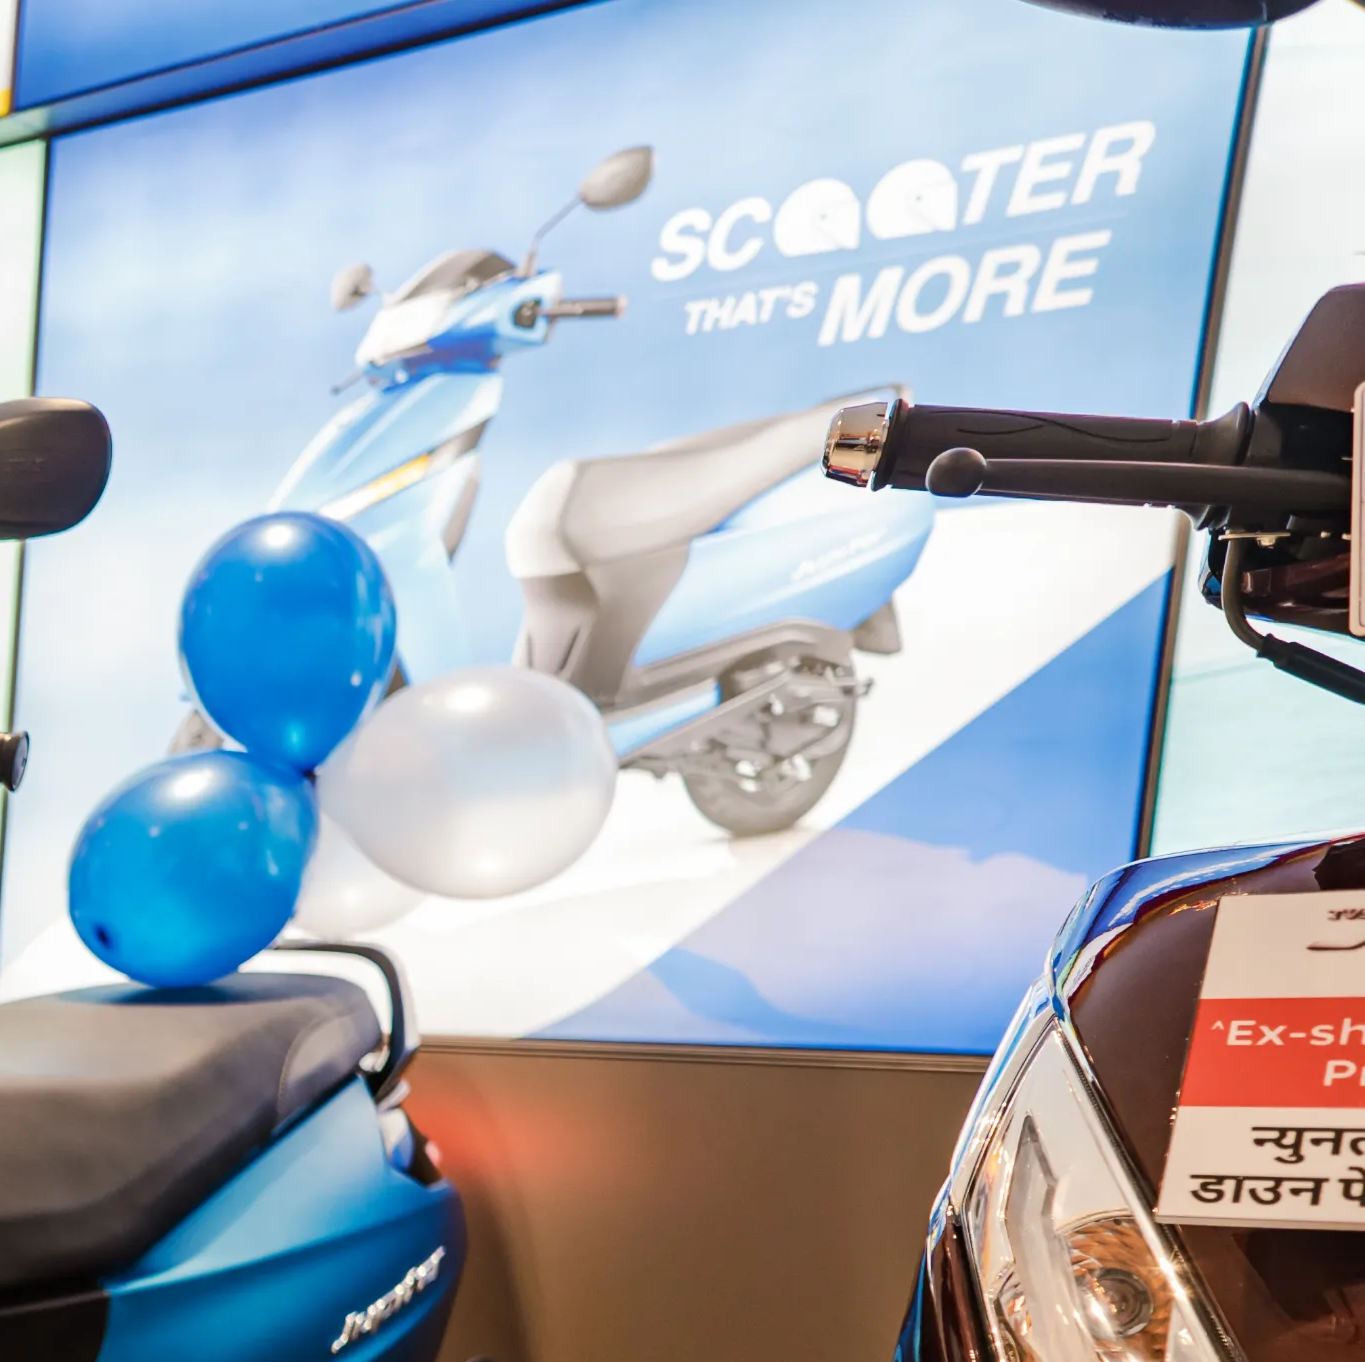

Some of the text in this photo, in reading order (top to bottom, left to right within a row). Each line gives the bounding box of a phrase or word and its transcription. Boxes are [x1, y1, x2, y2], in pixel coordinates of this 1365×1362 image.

[685, 229, 1113, 347] THAT'S MORE
[1189, 1173, 1330, 1206] डाउन
